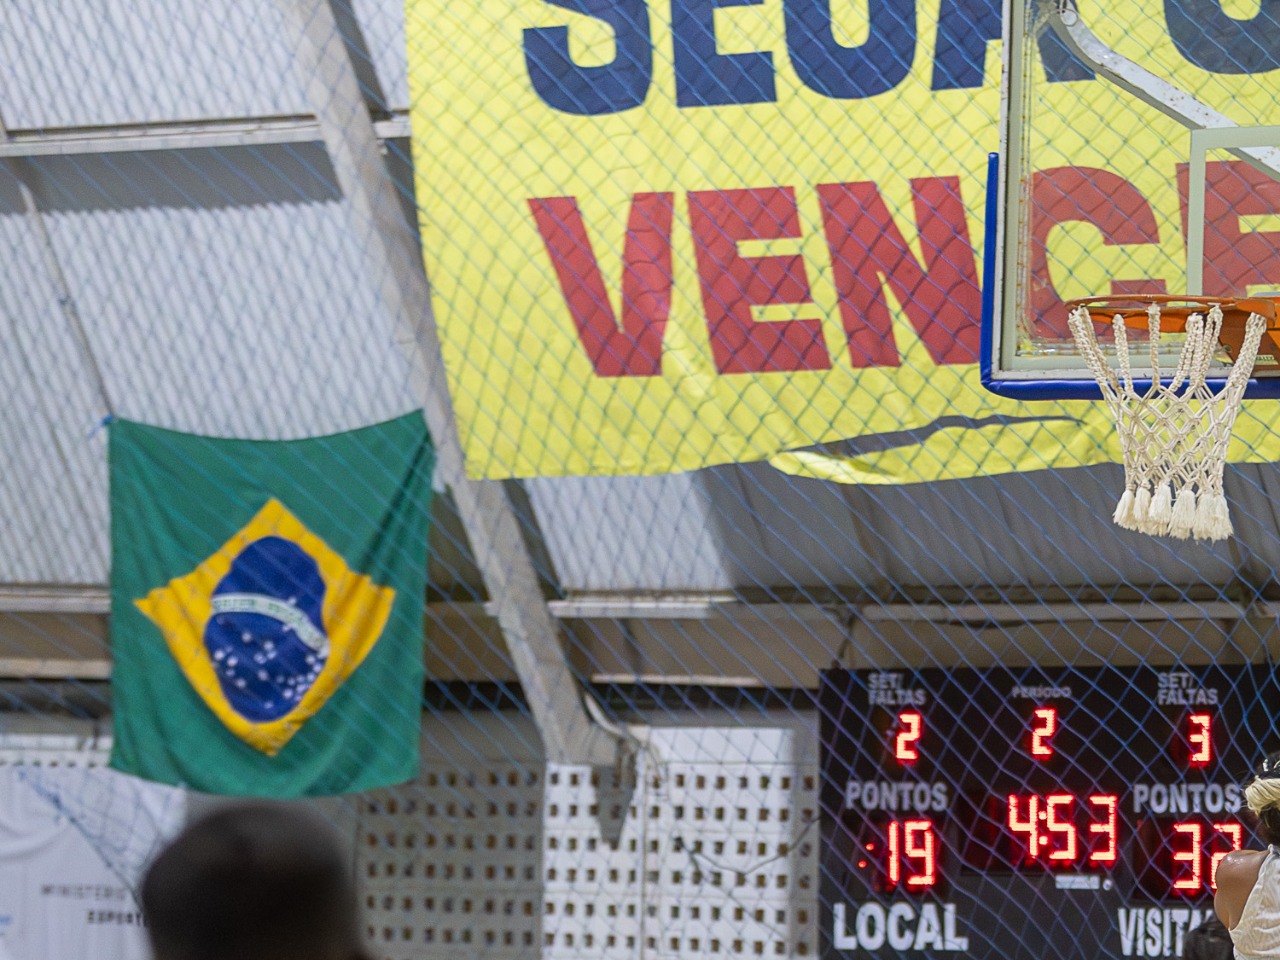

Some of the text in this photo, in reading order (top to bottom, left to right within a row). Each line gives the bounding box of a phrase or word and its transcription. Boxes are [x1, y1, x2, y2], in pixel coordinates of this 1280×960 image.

[1158, 688, 1219, 705] FALTAS
[896, 713, 921, 760] 2
[1032, 708, 1055, 755] 2
[1190, 715, 1210, 762] 3
[845, 781, 948, 812] PONTOS
[1133, 783, 1243, 814] PONTOS
[1009, 794, 1118, 862] 4:53
[889, 821, 935, 886] 19
[832, 902, 969, 951] LOCAL
[1117, 907, 1214, 958] VISIT
